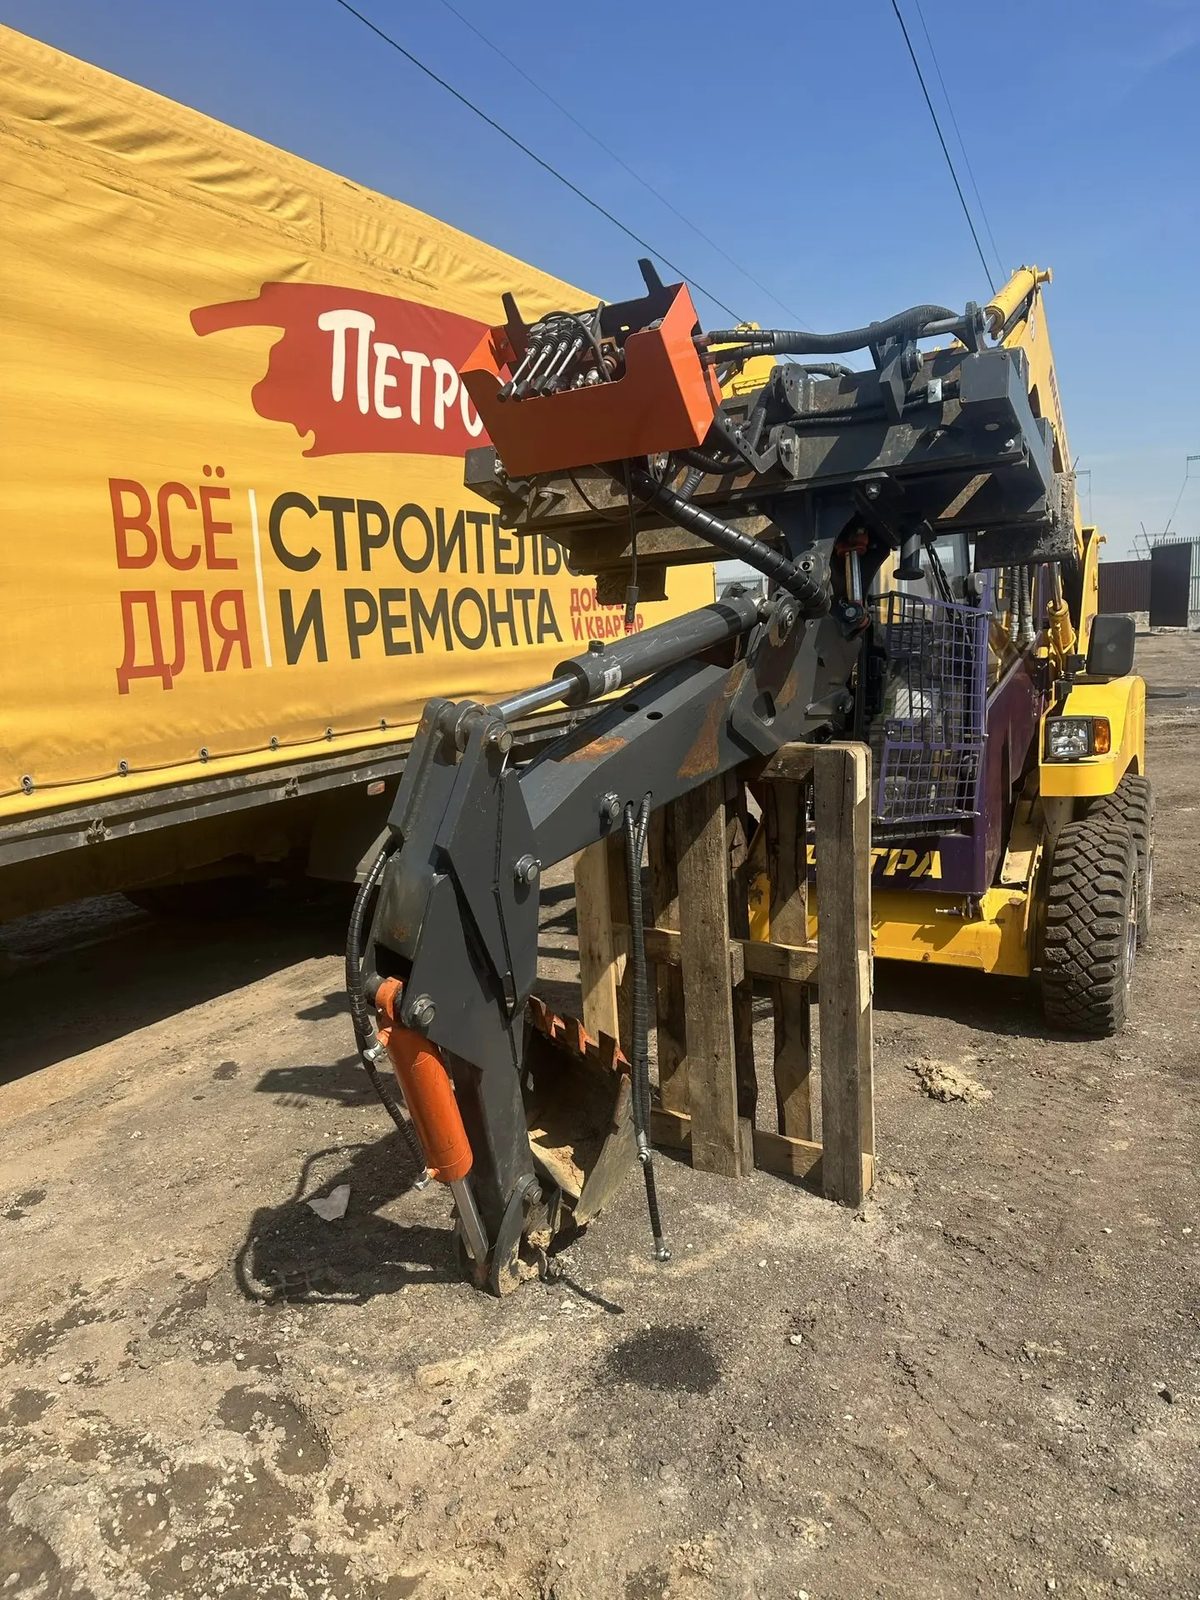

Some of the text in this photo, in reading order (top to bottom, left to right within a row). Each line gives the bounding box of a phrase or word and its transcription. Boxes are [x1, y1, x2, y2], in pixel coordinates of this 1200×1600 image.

[108, 464, 239, 571] ВСЁ
[116, 589, 252, 695] ДЛЯ
[279, 587, 563, 665] И РЕМОНТА
[571, 617, 584, 640] И
